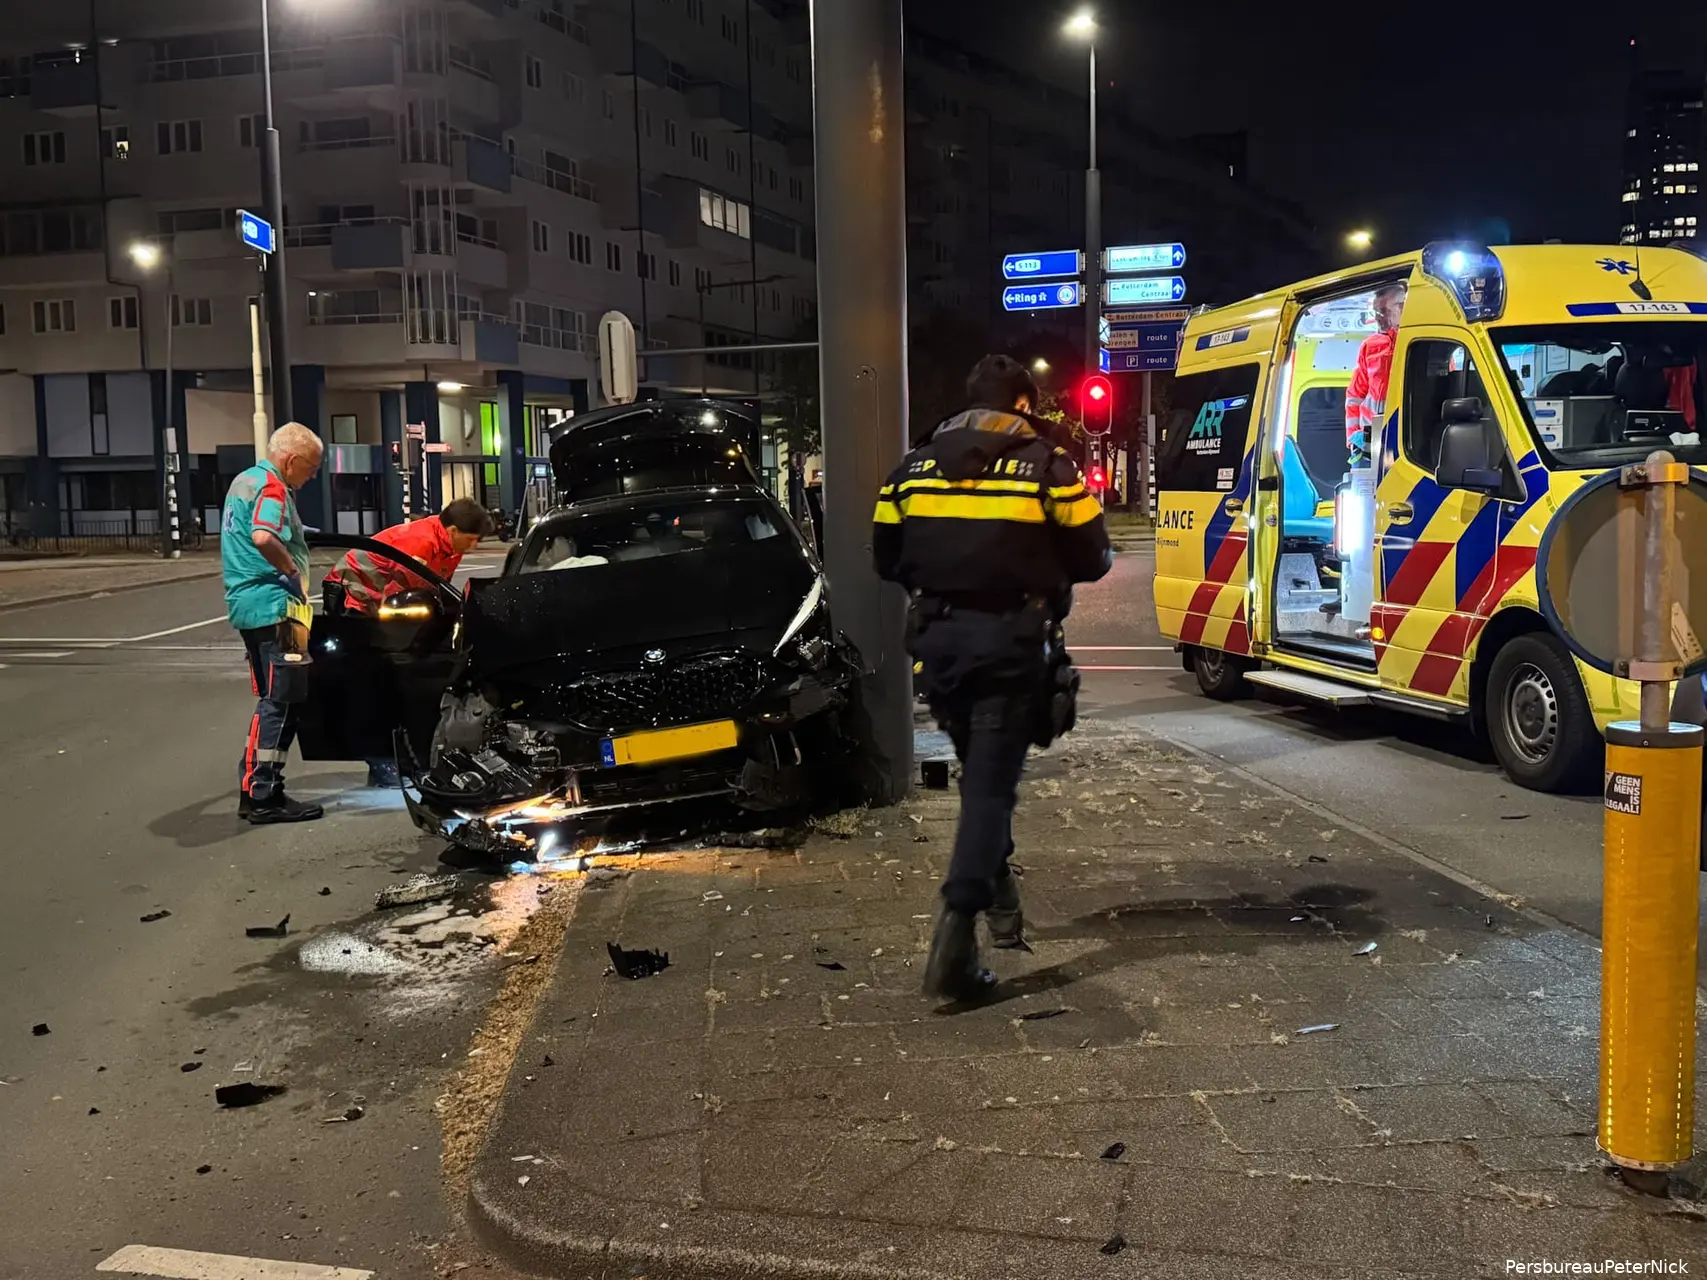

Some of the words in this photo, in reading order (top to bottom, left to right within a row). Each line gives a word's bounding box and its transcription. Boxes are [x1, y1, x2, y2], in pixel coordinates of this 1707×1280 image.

[1014, 292, 1037, 304] Ring
[1629, 303, 1679, 312] 17-143
[1115, 312, 1154, 320] Rotterdam
[1155, 311, 1186, 319] Centraal
[1147, 356, 1168, 364] route
[1188, 400, 1225, 439] ARR
[1185, 438, 1222, 450] AMBULANCE
[603, 755, 614, 763] NL
[1615, 775, 1641, 787] GEEN
[1613, 783, 1640, 796] MENS
[1630, 795, 1640, 805] IS
